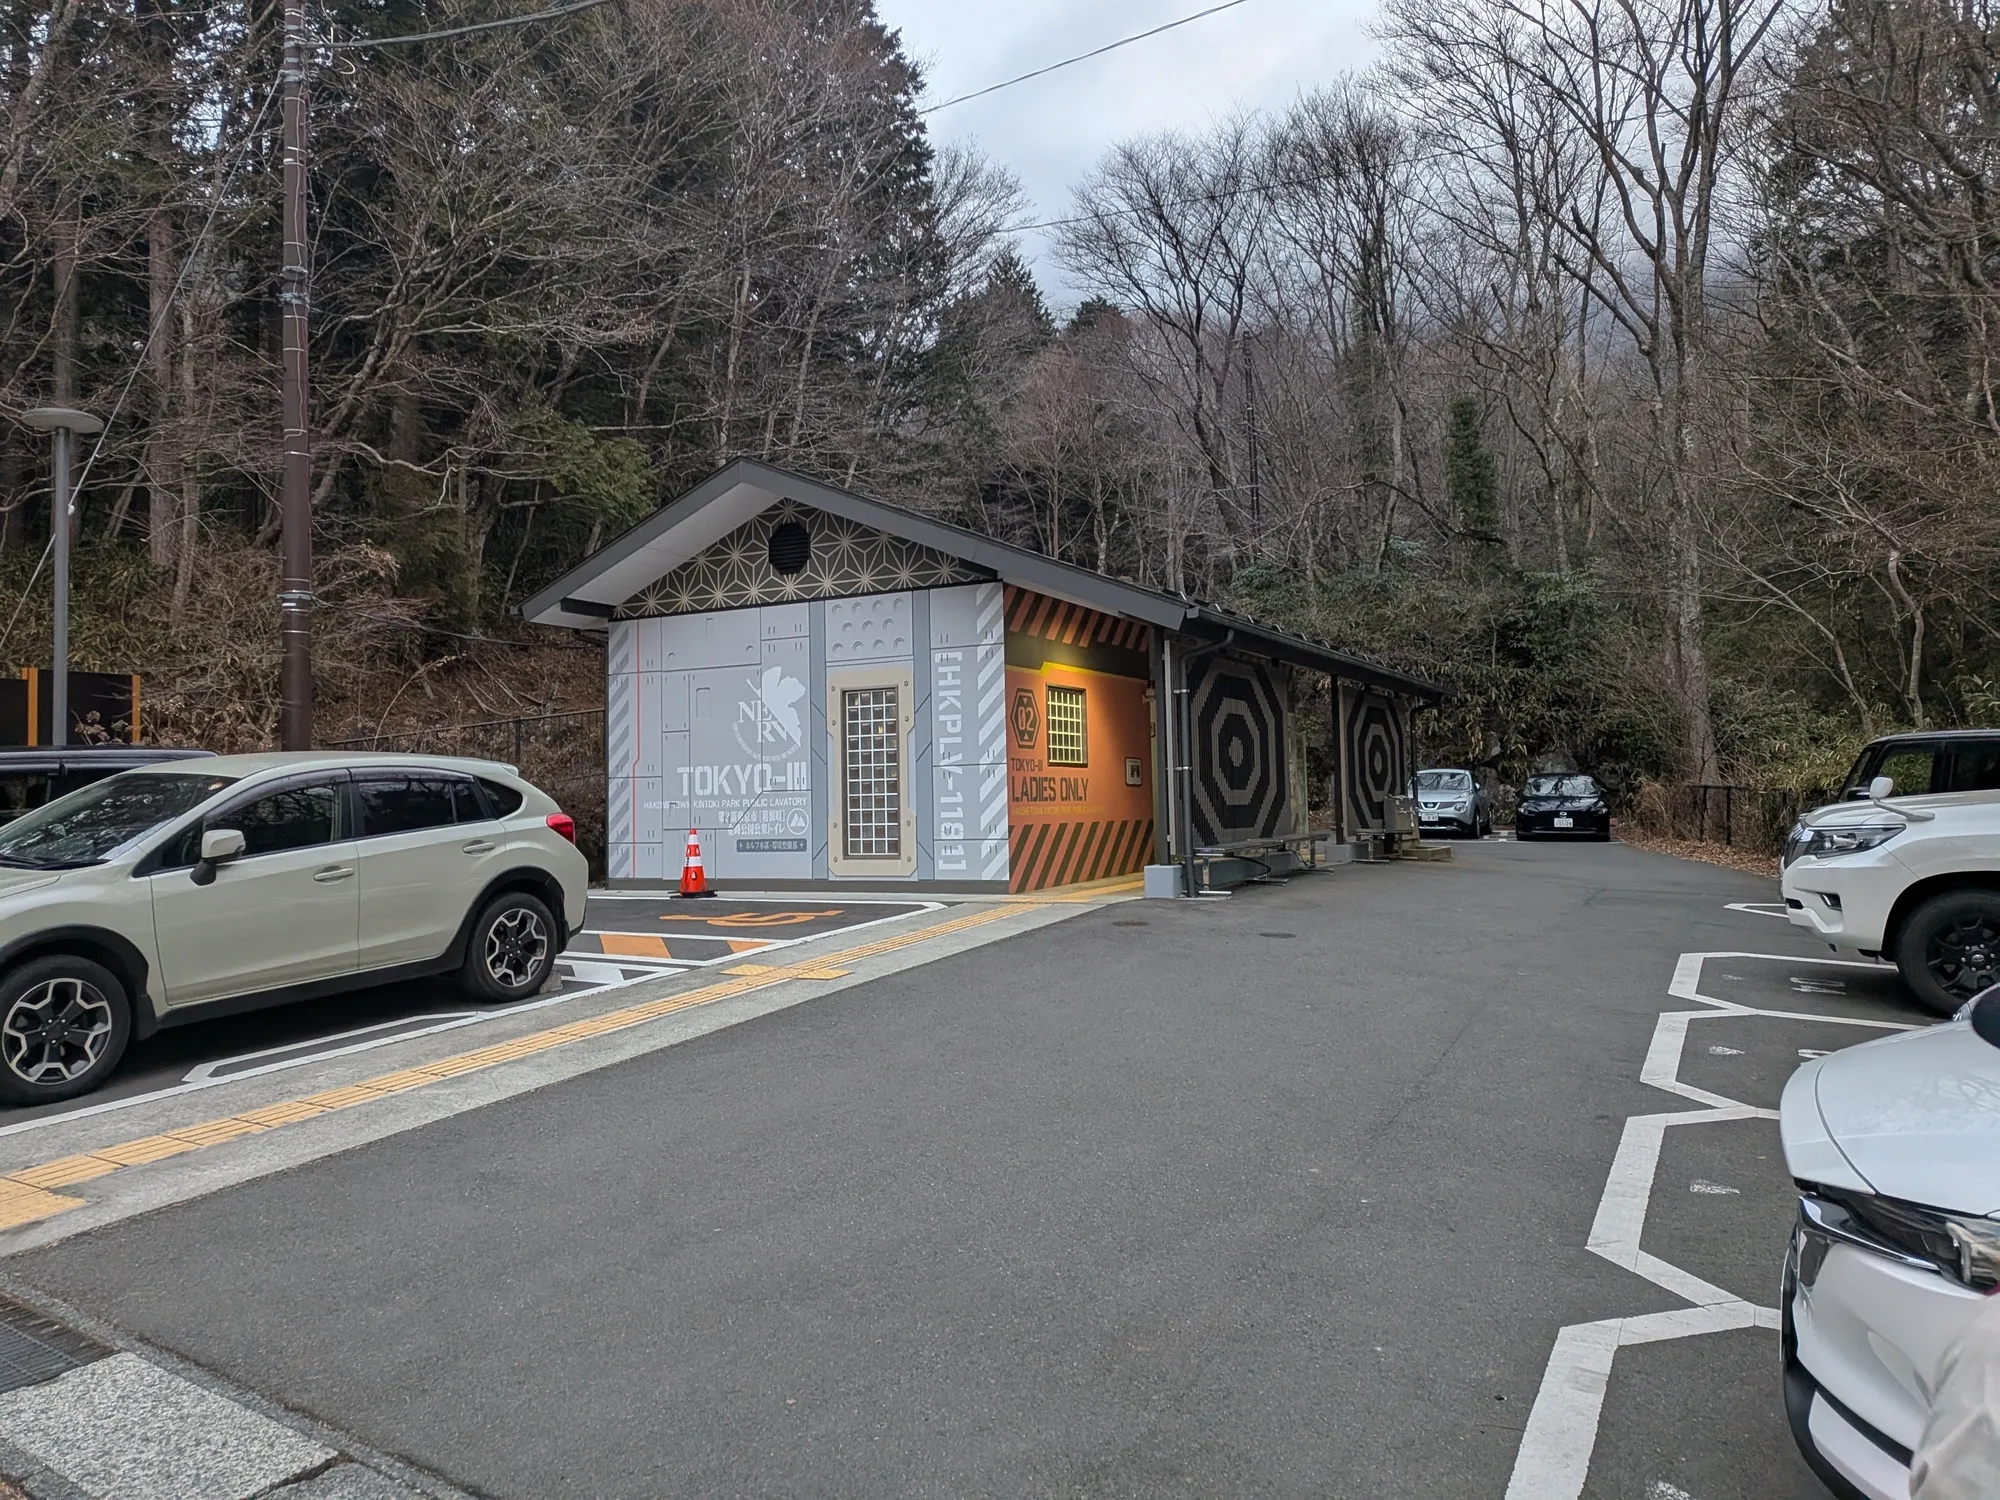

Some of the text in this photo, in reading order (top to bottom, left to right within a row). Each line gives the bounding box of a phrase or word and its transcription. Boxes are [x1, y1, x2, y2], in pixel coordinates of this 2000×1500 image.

[1018, 706, 1034, 731] 02
[677, 762, 806, 796] TOKYO-III
[1012, 776, 1089, 802] LADIES ONLY
[722, 799, 740, 808] PARK
[743, 798, 768, 807] PUBLIC
[770, 796, 807, 806] LAVATORY
